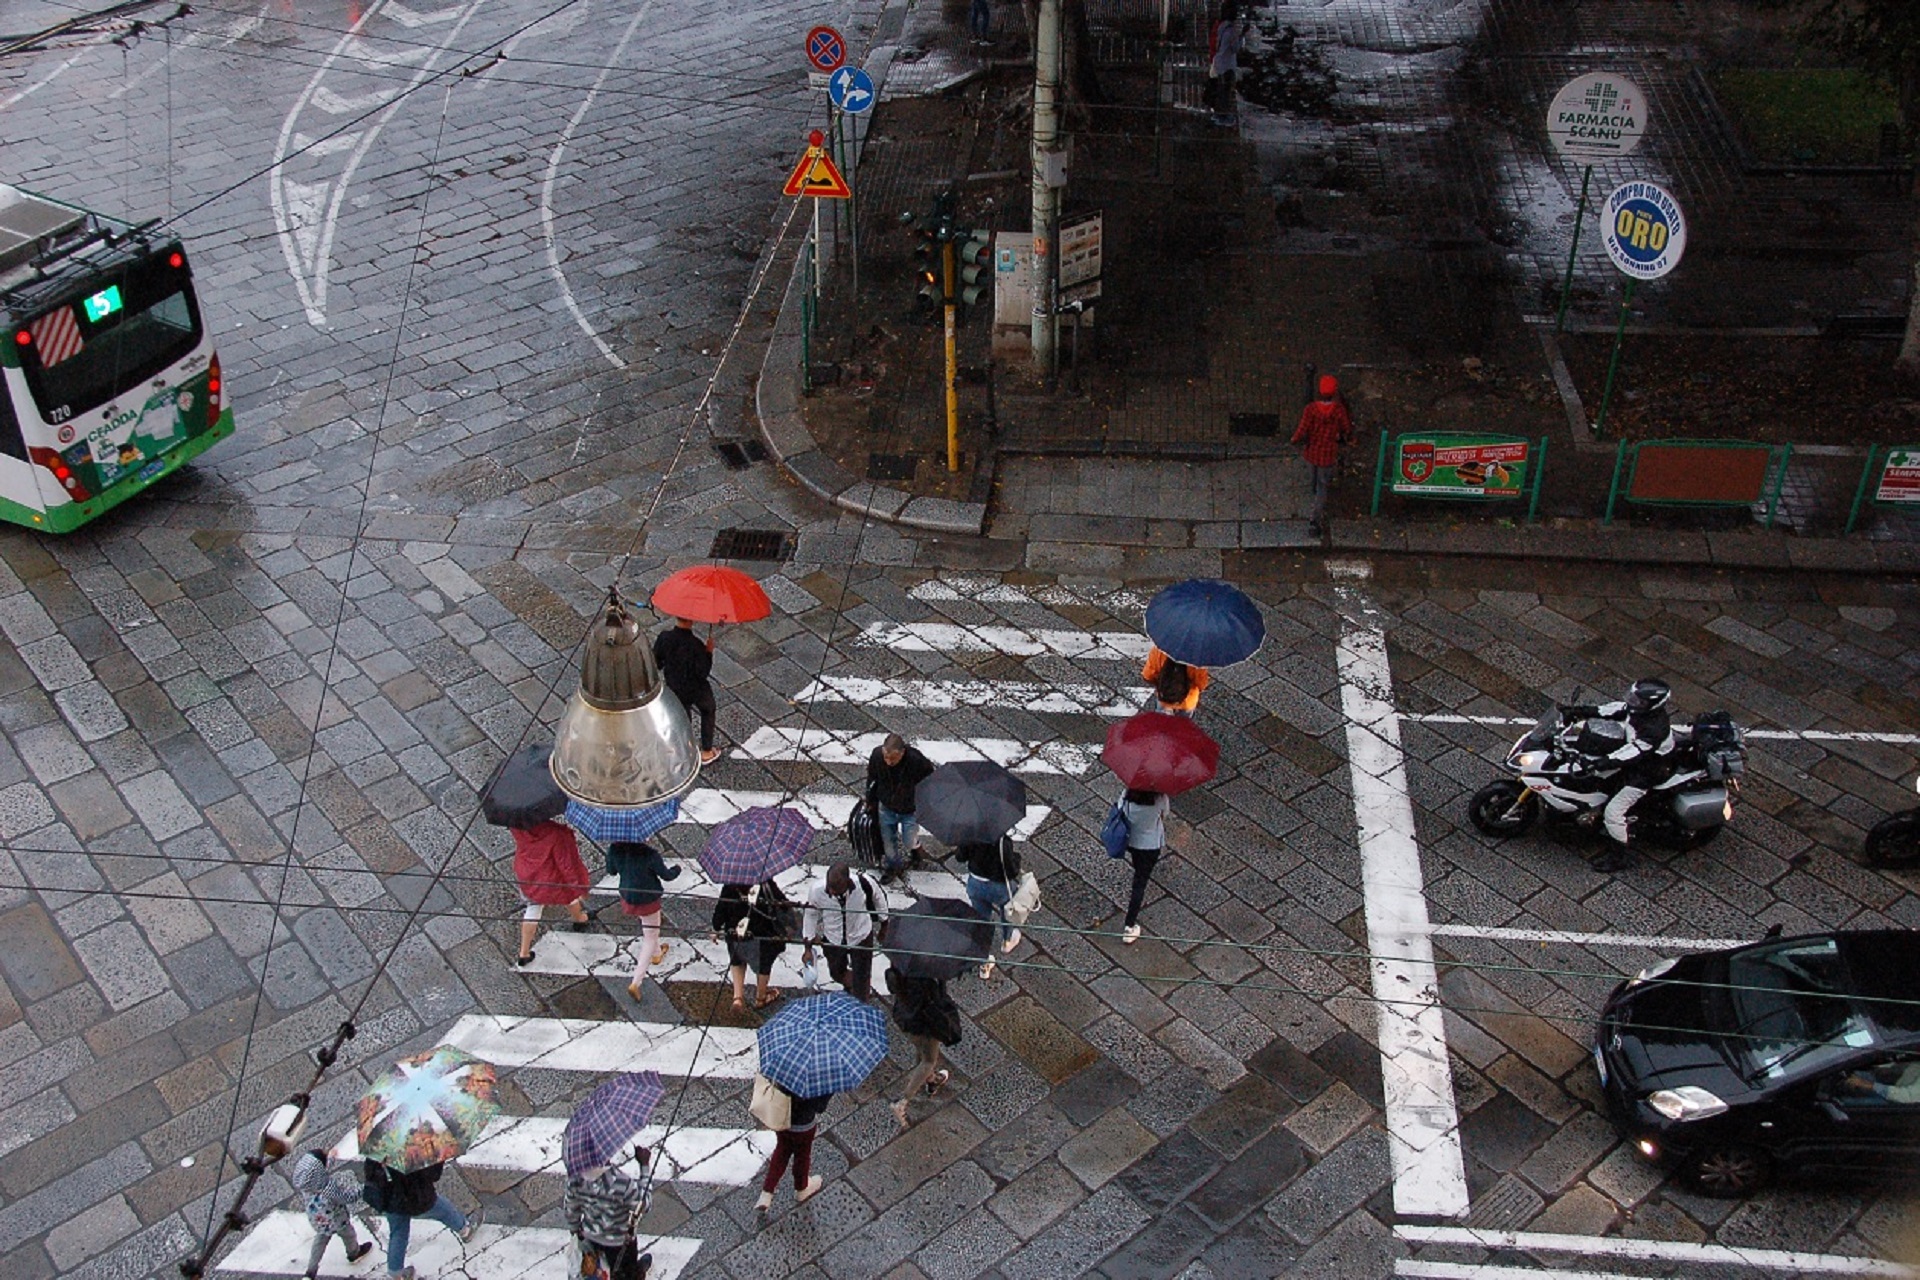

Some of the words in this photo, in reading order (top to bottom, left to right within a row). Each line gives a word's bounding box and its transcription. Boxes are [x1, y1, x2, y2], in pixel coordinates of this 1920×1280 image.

[1558, 112, 1635, 129] FARMACIA
[1569, 125, 1622, 140] SCANU
[1610, 183, 1645, 213] COMPRO
[1645, 185, 1662, 205] ORO
[1660, 196, 1681, 236] USATO
[1617, 209, 1667, 251] ORO
[1607, 235, 1619, 255] VIA
[92, 290, 111, 316] 5
[49, 404, 71, 423] 720
